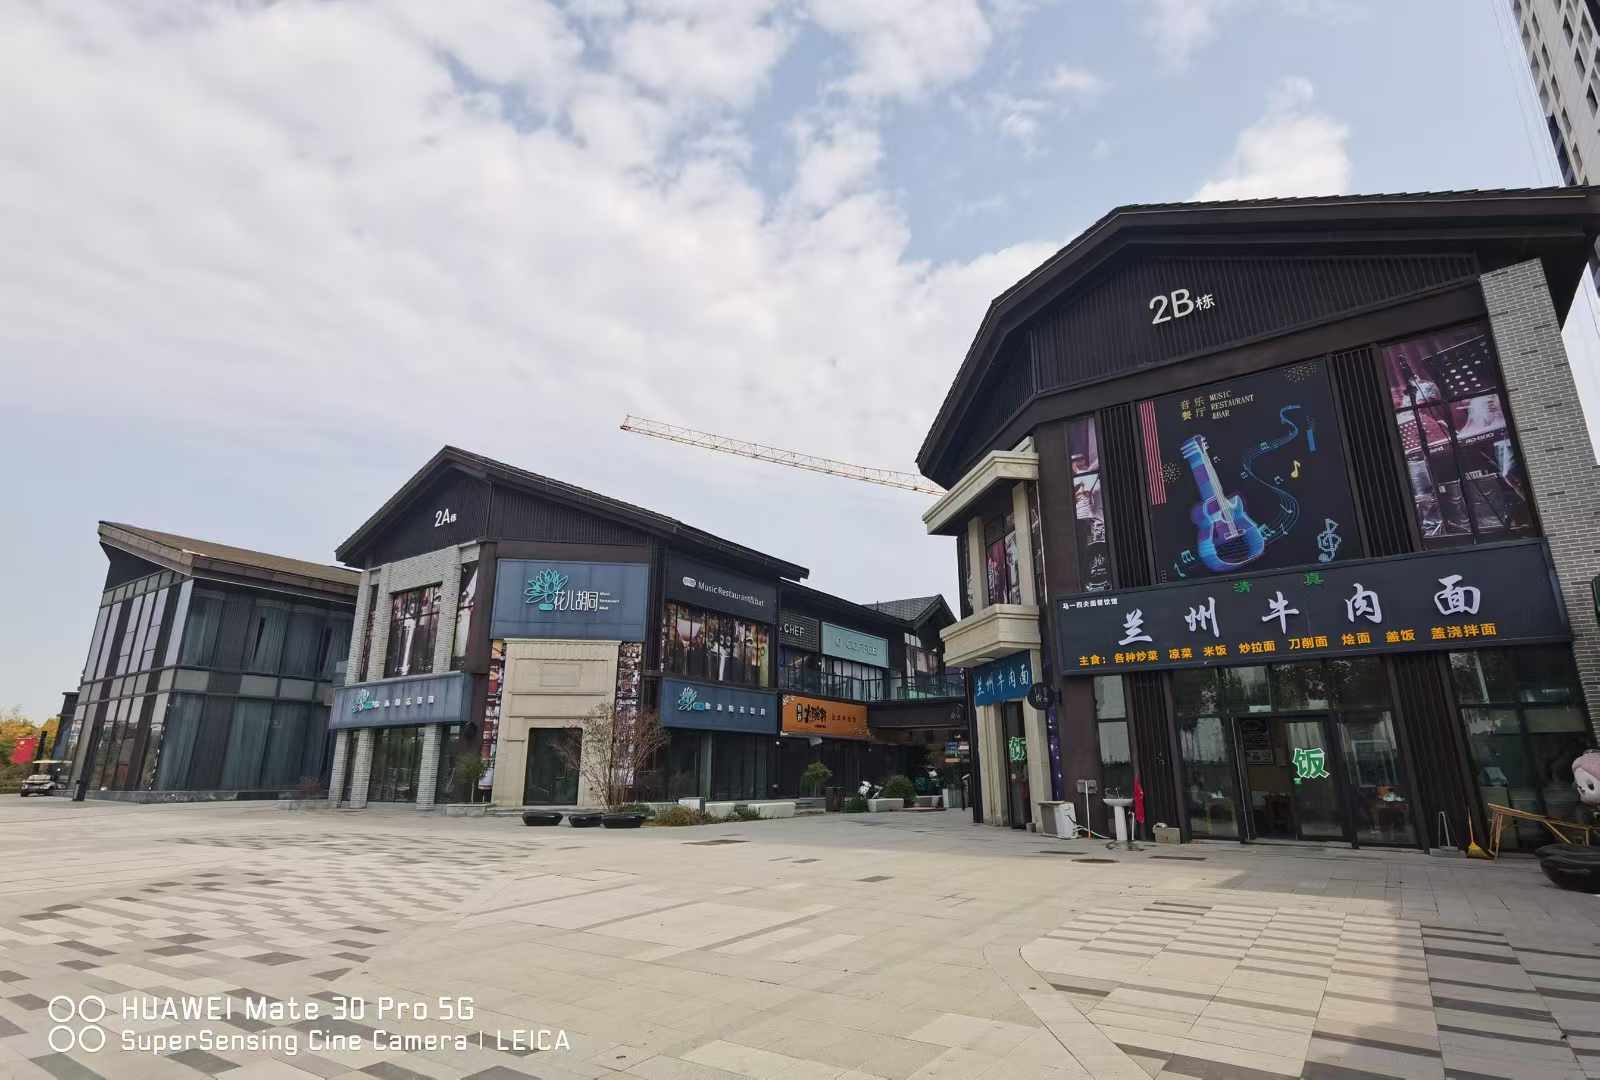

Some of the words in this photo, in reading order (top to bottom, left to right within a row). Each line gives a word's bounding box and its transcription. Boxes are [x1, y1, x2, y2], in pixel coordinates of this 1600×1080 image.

[1149, 288, 1216, 325] 2B栋
[1209, 391, 1231, 401] MUSIC
[1210, 394, 1254, 411] RESTAURANT
[1118, 574, 1481, 646] 兰州牛肉面
[784, 623, 806, 636] CHEF
[1114, 650, 1159, 664] 各种炒菜
[1168, 647, 1193, 660] 凉菜
[1203, 644, 1227, 657] 米饭
[1238, 640, 1276, 654] 炒拉面
[1288, 635, 1328, 650] 刀削面
[1341, 632, 1371, 645] 烩面
[1385, 629, 1416, 642] 盖饭
[1431, 623, 1497, 640] 盖浇拌面
[1291, 747, 1330, 779] 饭
